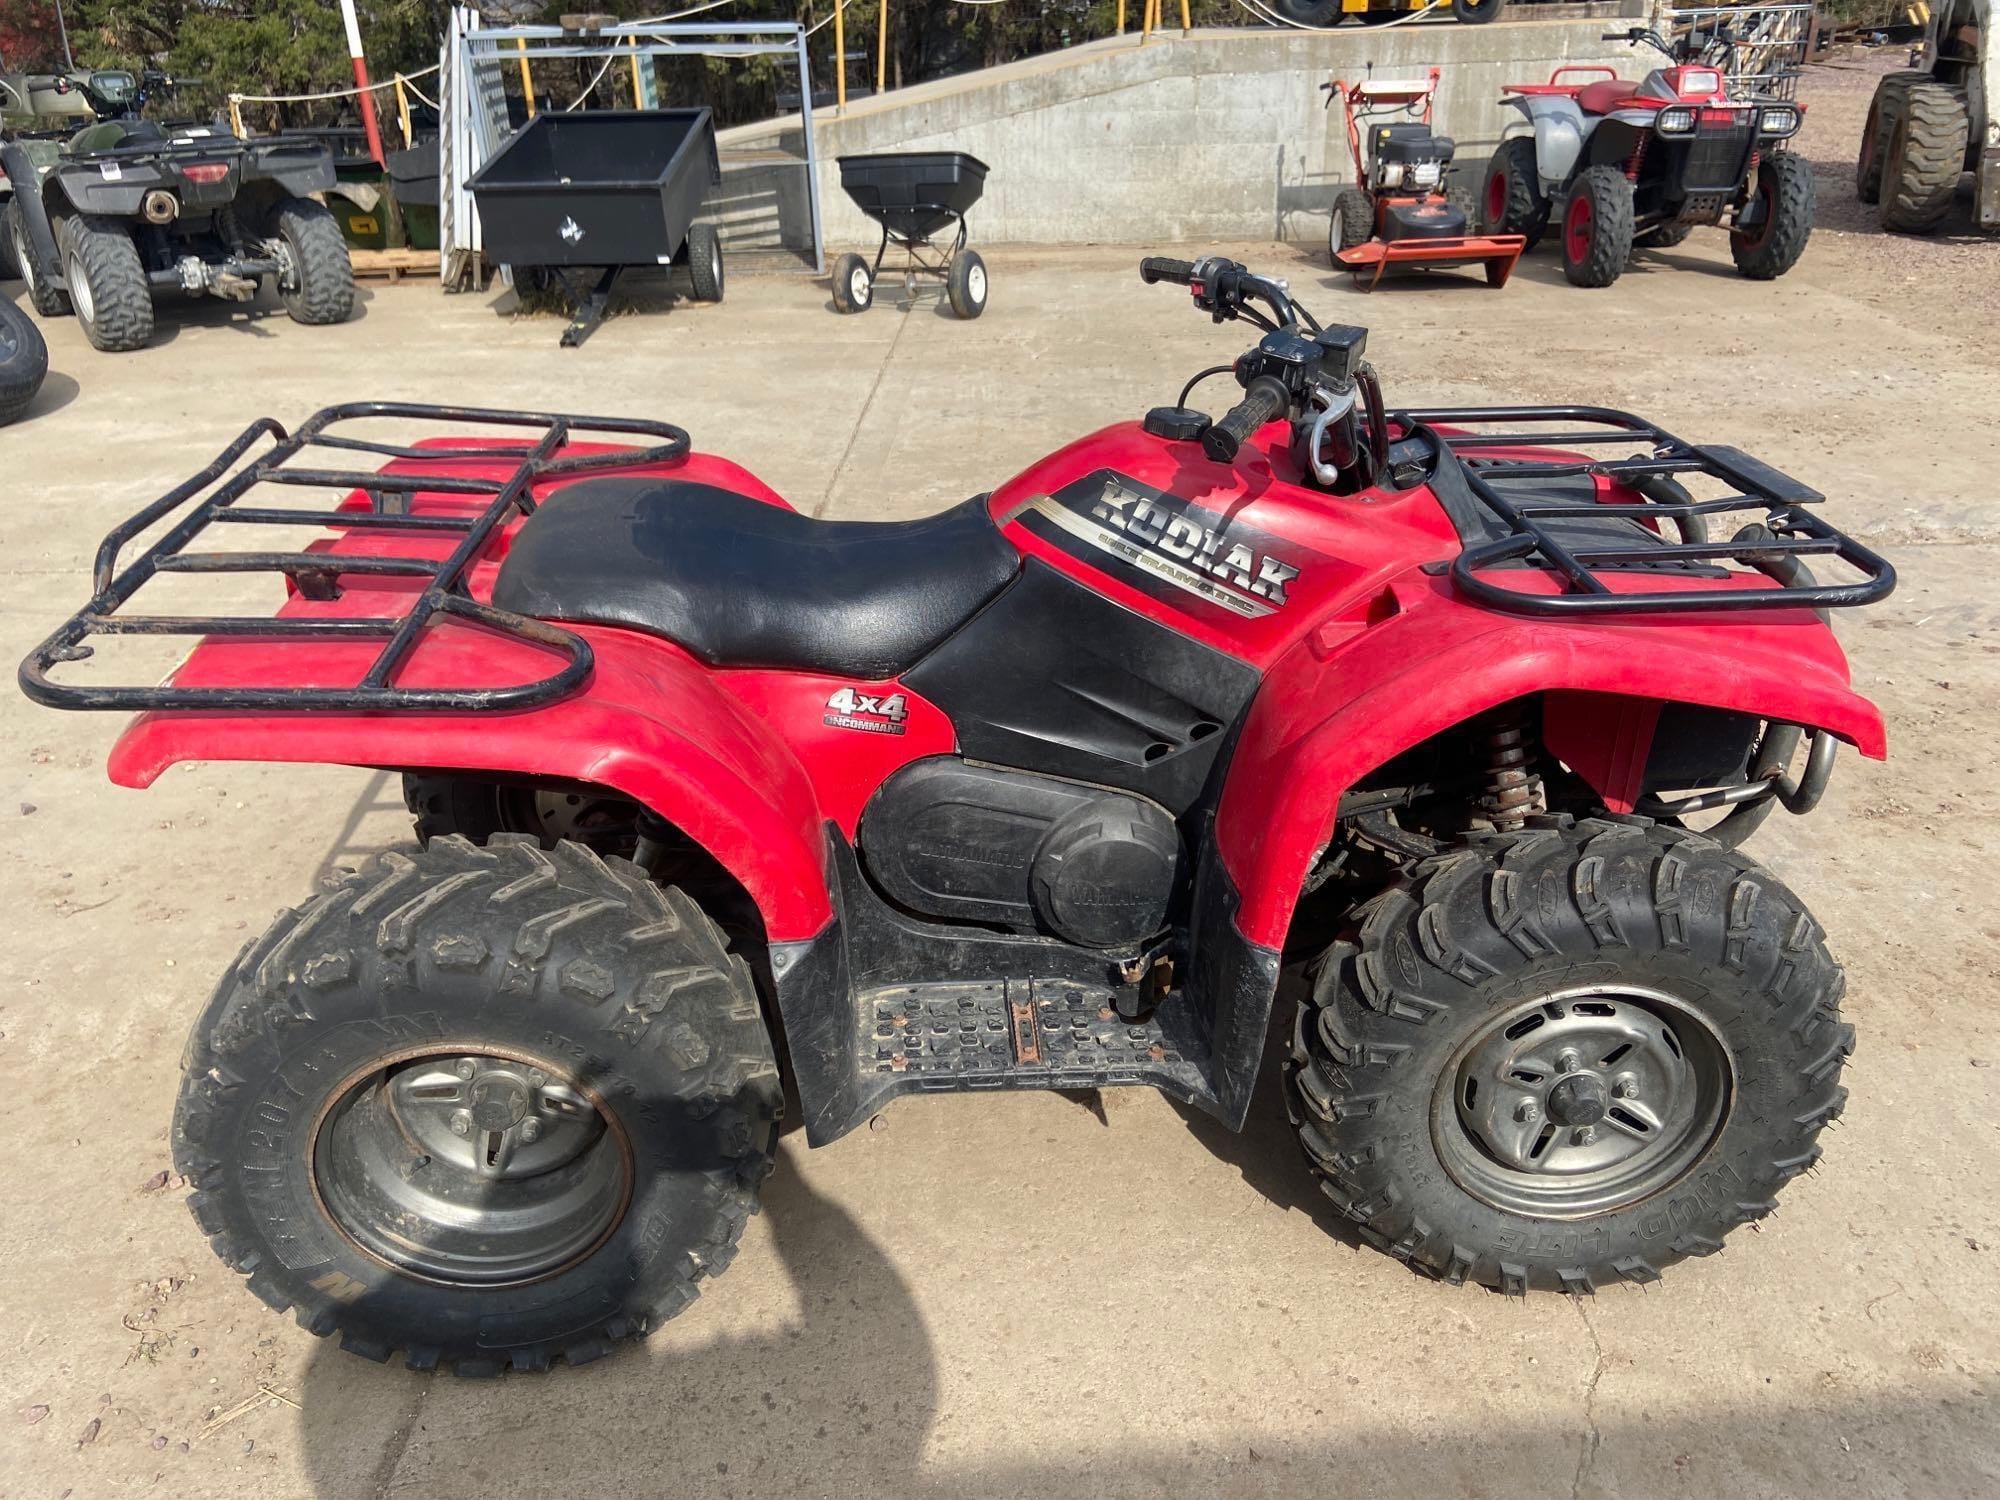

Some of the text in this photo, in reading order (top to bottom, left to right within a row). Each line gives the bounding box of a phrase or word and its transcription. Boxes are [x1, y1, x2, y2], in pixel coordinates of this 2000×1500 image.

[1091, 481, 1301, 607] KODIAK
[1098, 532, 1255, 613] ULTRAMATIC
[824, 715, 906, 735] ONCOMMAND
[827, 687, 907, 722] 4x4
[1491, 1162, 1742, 1258] MUD LITE
